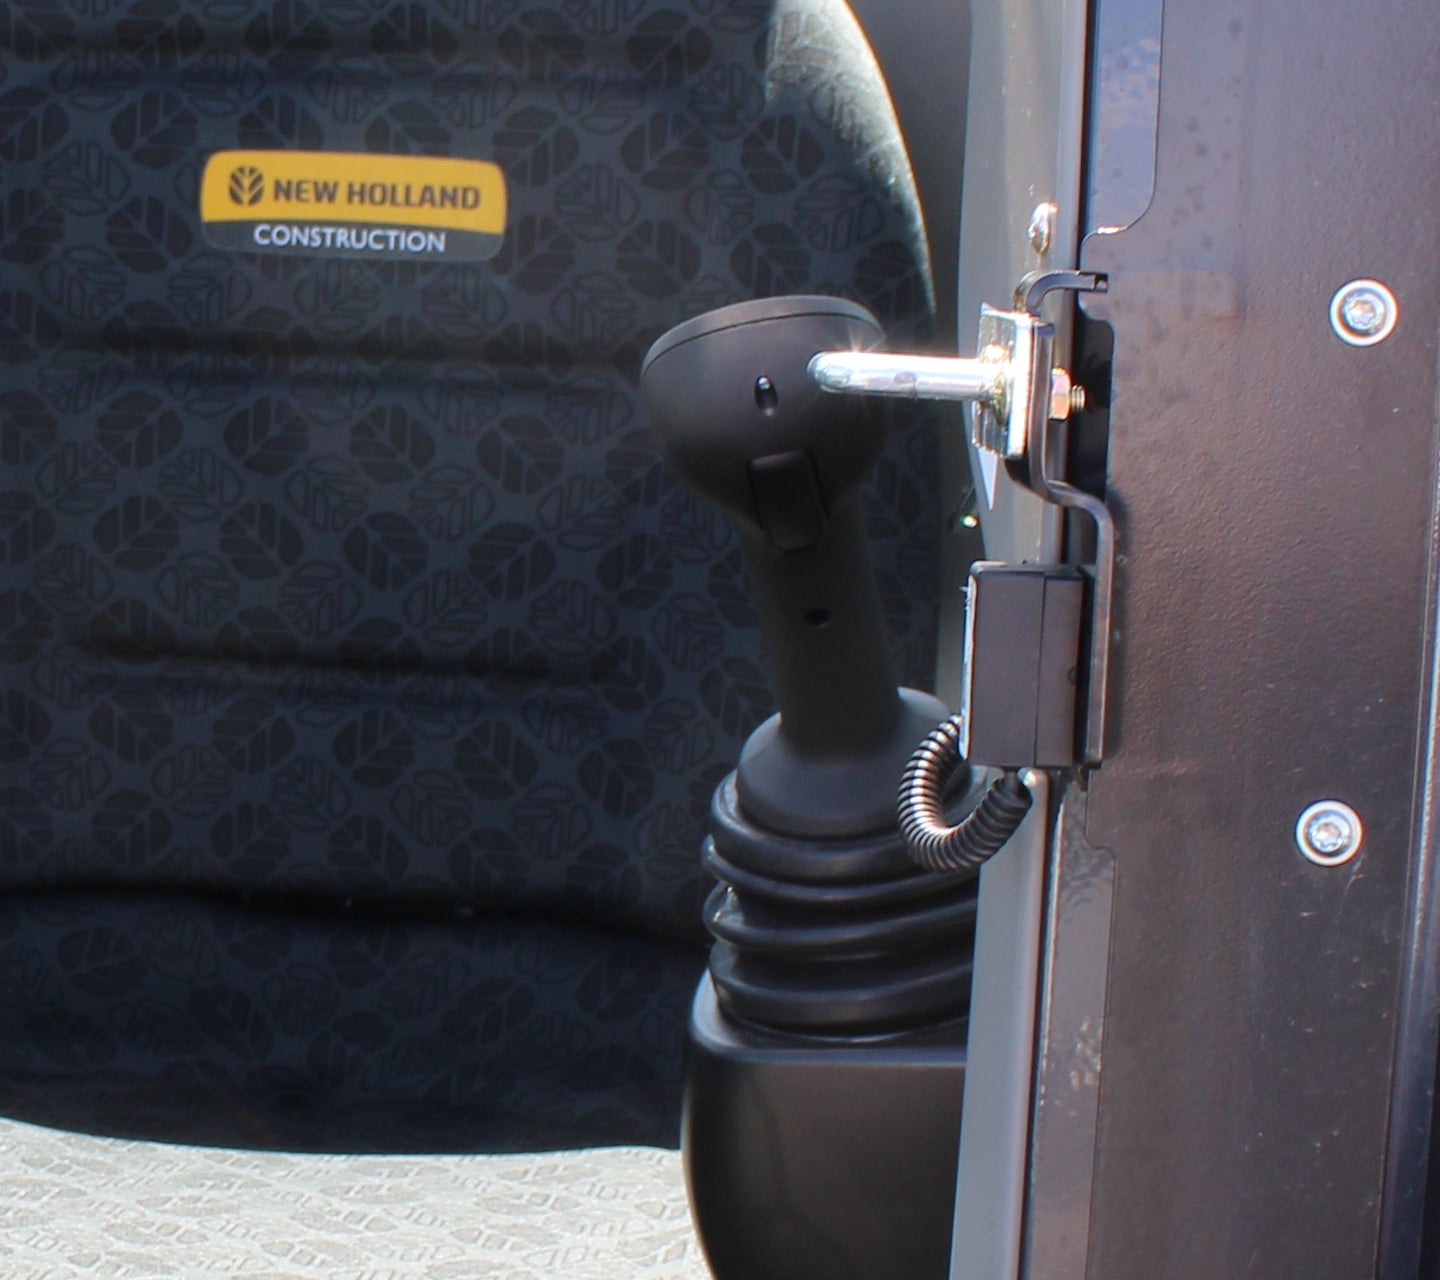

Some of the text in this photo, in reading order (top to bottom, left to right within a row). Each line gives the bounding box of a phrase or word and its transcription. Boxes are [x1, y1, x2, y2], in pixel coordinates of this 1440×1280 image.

[272, 178, 481, 211] NEW HOLLAND
[252, 223, 448, 254] CONSTRUCTION
